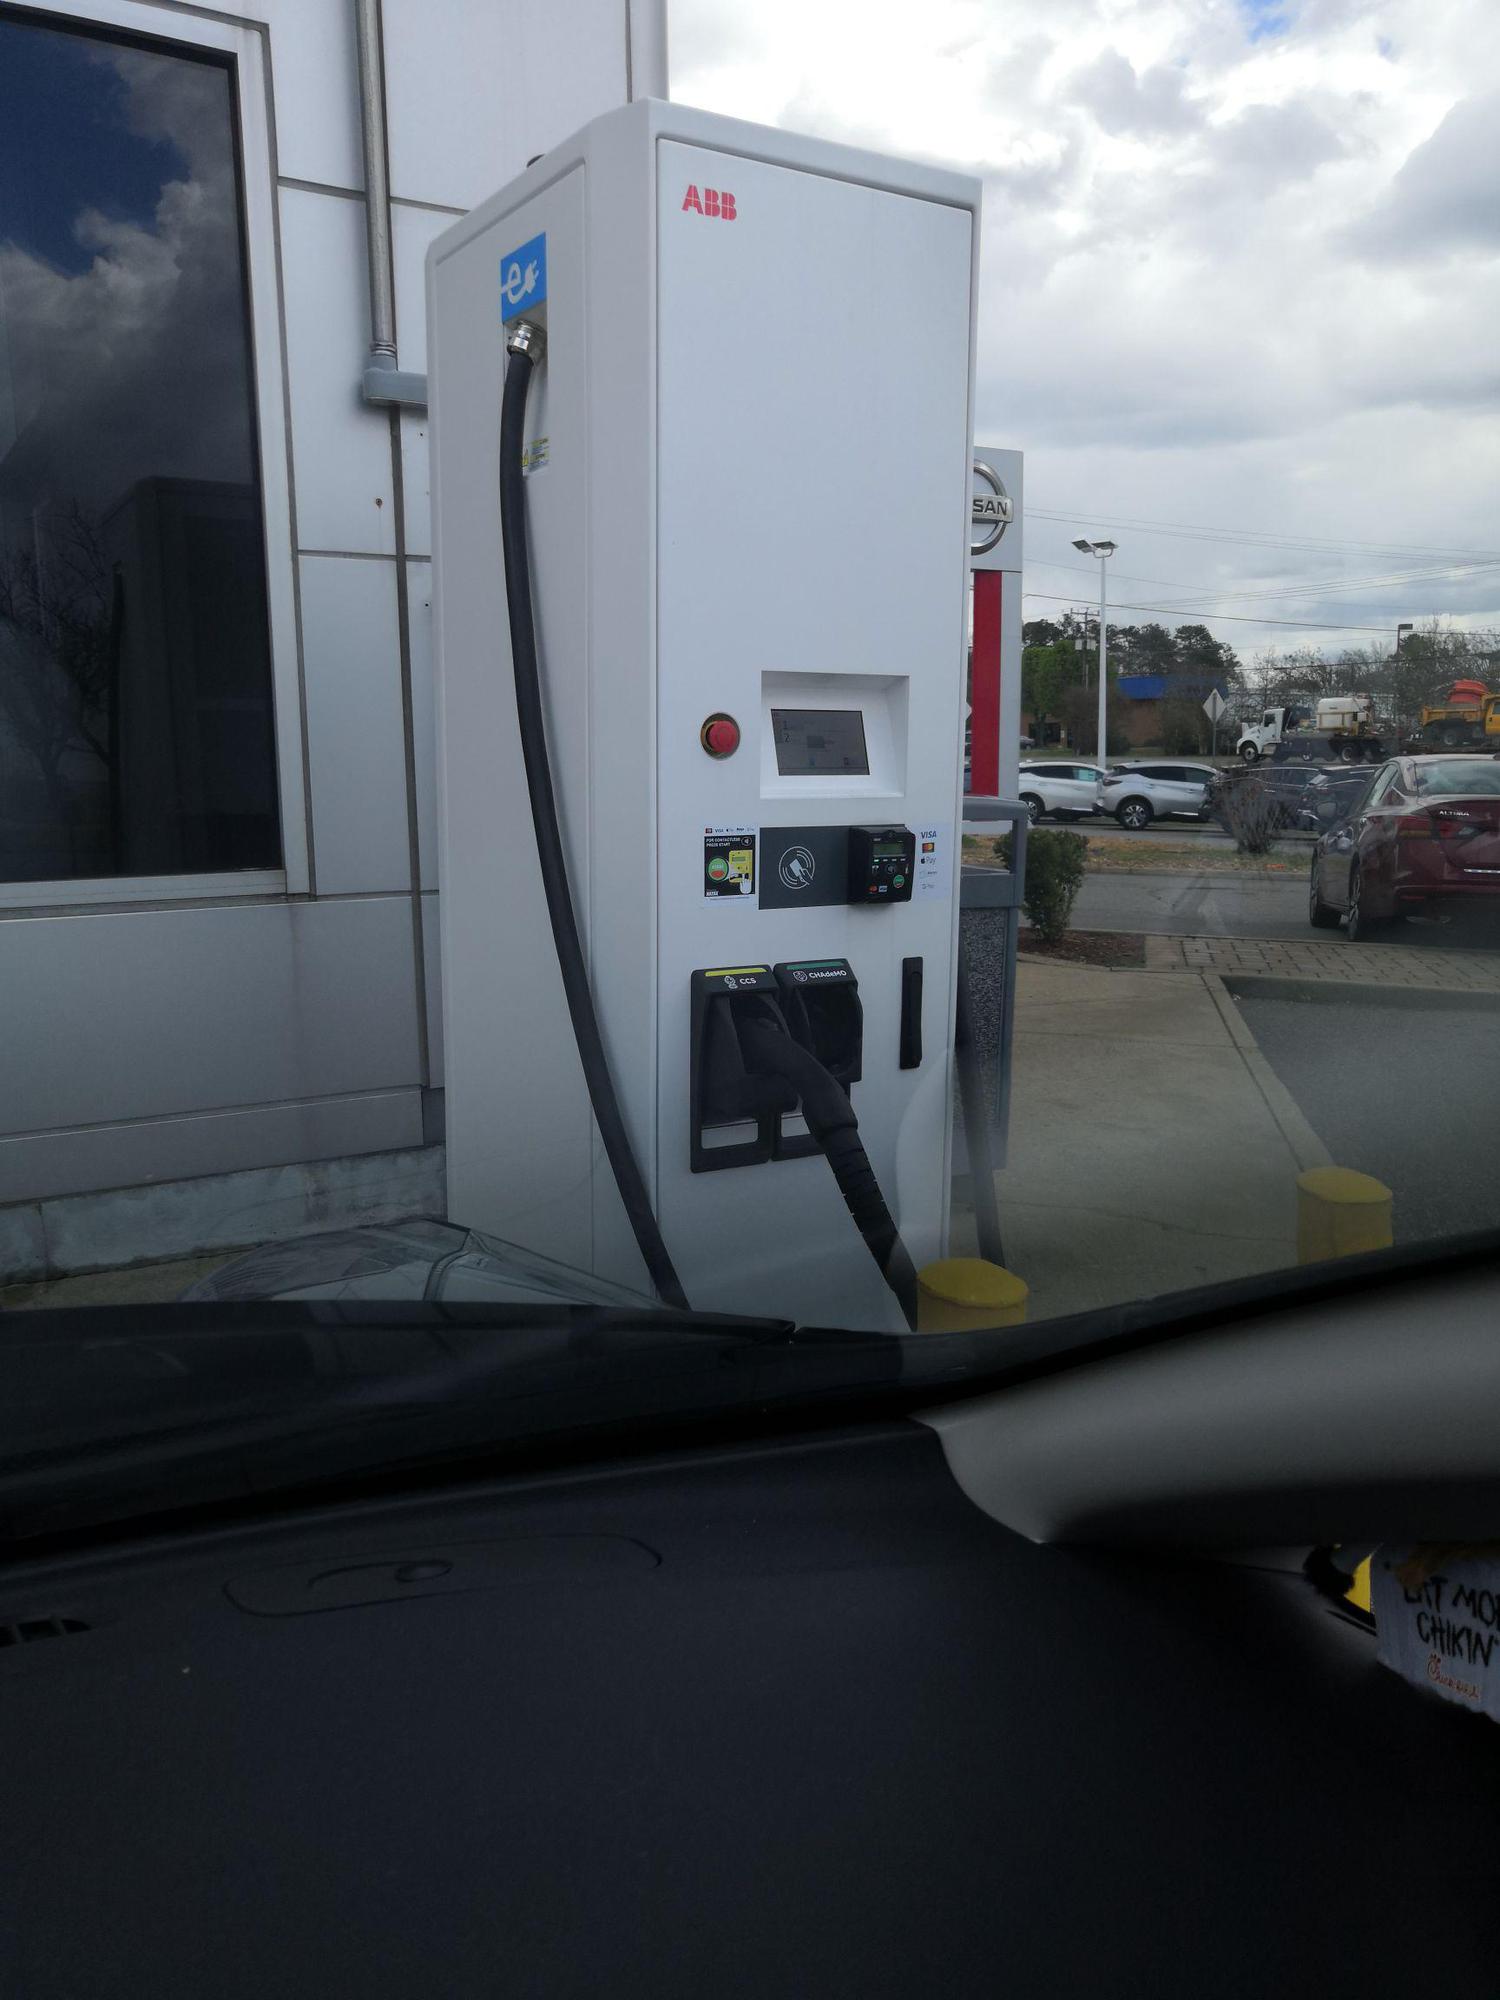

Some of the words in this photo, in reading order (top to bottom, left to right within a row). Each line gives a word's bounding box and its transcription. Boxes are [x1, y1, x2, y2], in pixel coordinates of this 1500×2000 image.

[681, 184, 738, 221] ABB
[920, 830, 937, 839] VISA
[926, 856, 937, 866] Pay
[808, 970, 847, 979] CHAdeMO
[739, 977, 757, 985] CCS
[1417, 1611, 1494, 1668] CHIKIN
